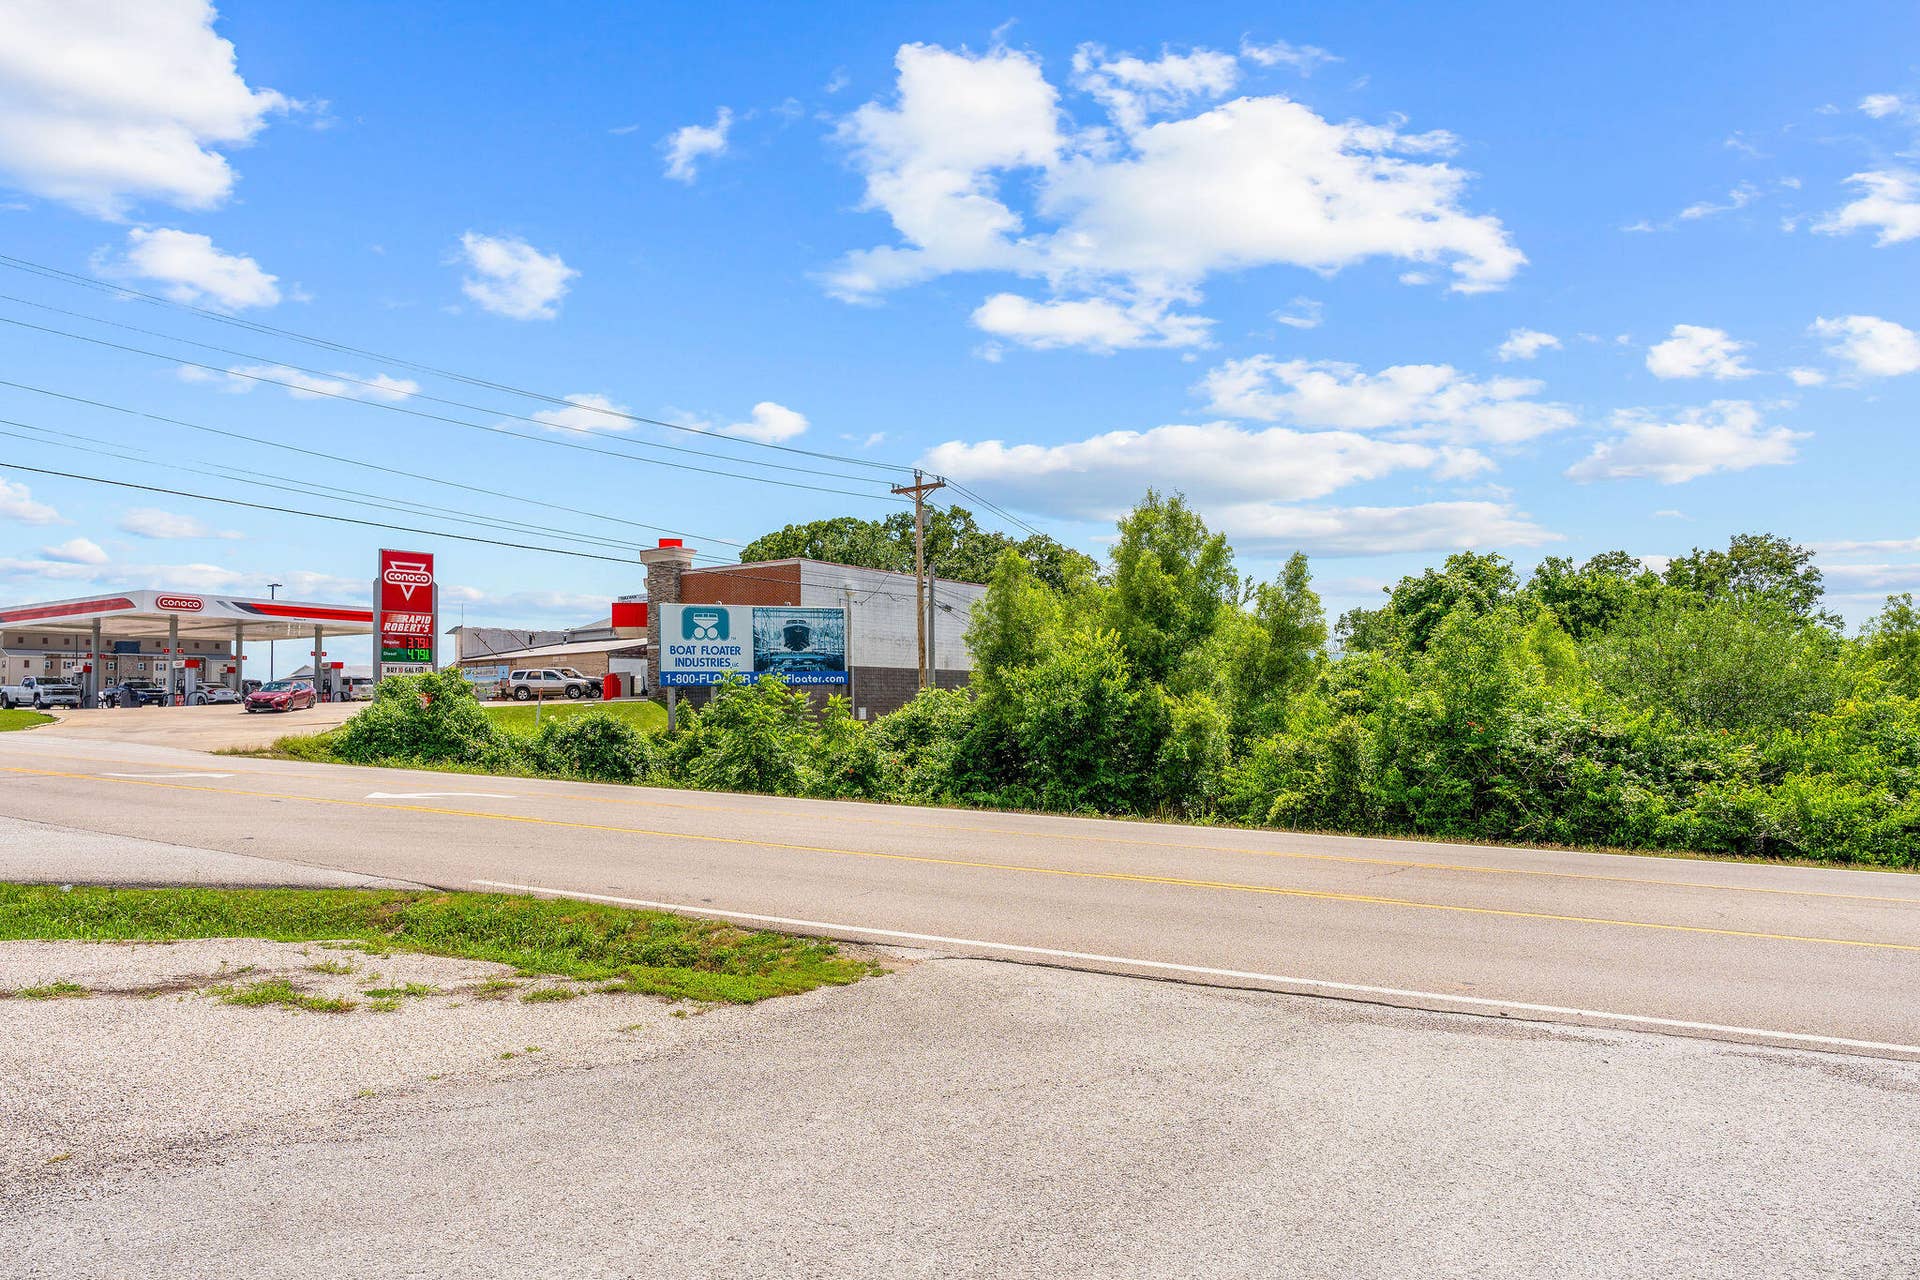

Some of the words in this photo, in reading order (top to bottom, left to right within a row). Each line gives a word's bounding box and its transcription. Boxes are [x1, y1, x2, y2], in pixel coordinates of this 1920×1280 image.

[401, 614, 432, 624] RAPID
[384, 622, 430, 633] ROBERT'S
[670, 645, 696, 655] BOAT
[701, 645, 741, 655] FLOATER
